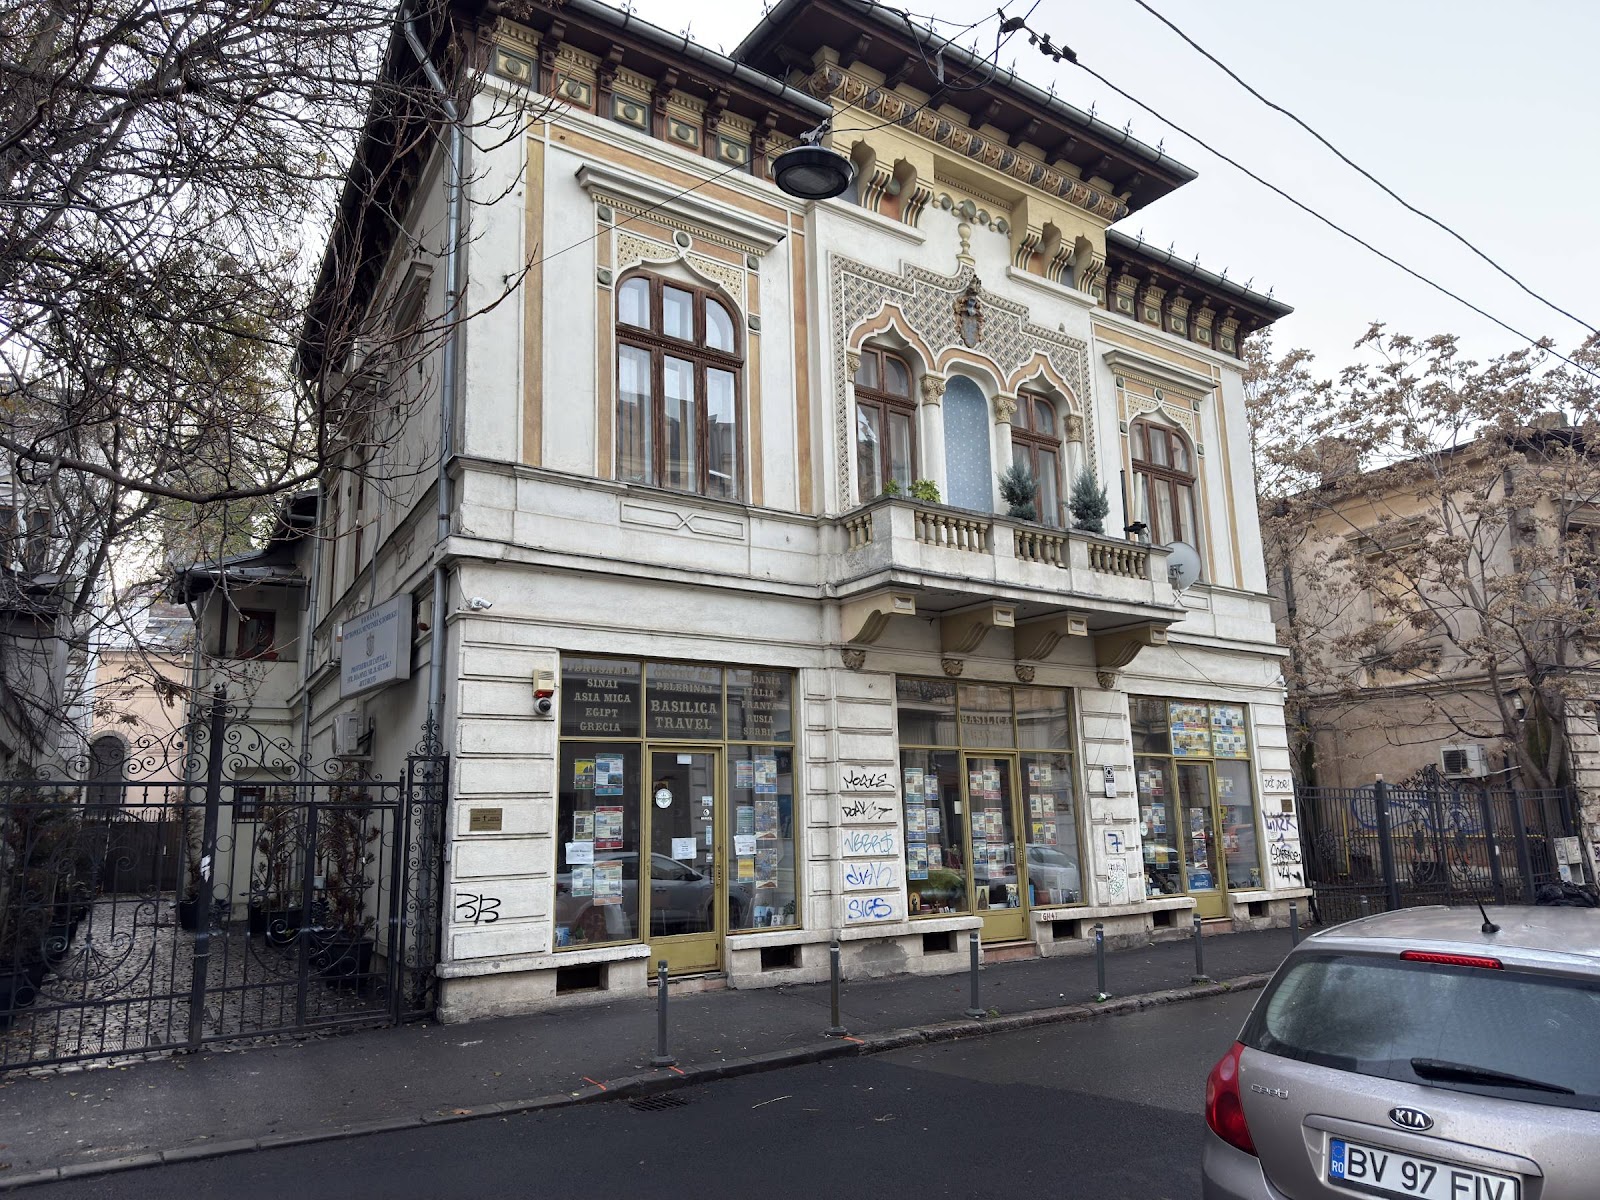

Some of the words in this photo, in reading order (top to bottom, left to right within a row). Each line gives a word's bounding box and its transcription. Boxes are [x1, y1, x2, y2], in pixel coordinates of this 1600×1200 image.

[587, 678, 618, 689] SINAI
[656, 682, 713, 693] PELERINAJ
[574, 692, 600, 702] ASIA
[603, 693, 631, 703] MICA
[743, 687, 775, 698] ITALIA
[585, 707, 618, 718] EGIPT
[651, 700, 717, 714] BASILICA
[655, 716, 713, 730] TRAVEL
[747, 714, 774, 724] RUSIA
[961, 714, 1011, 726] BASILICA
[580, 721, 621, 732] GRECIA
[743, 727, 777, 737] SERBIA
[1395, 1109, 1426, 1127] KIA
[1332, 1160, 1344, 1174] RO
[1347, 1147, 1388, 1183] BV
[1401, 1160, 1438, 1194] 97
